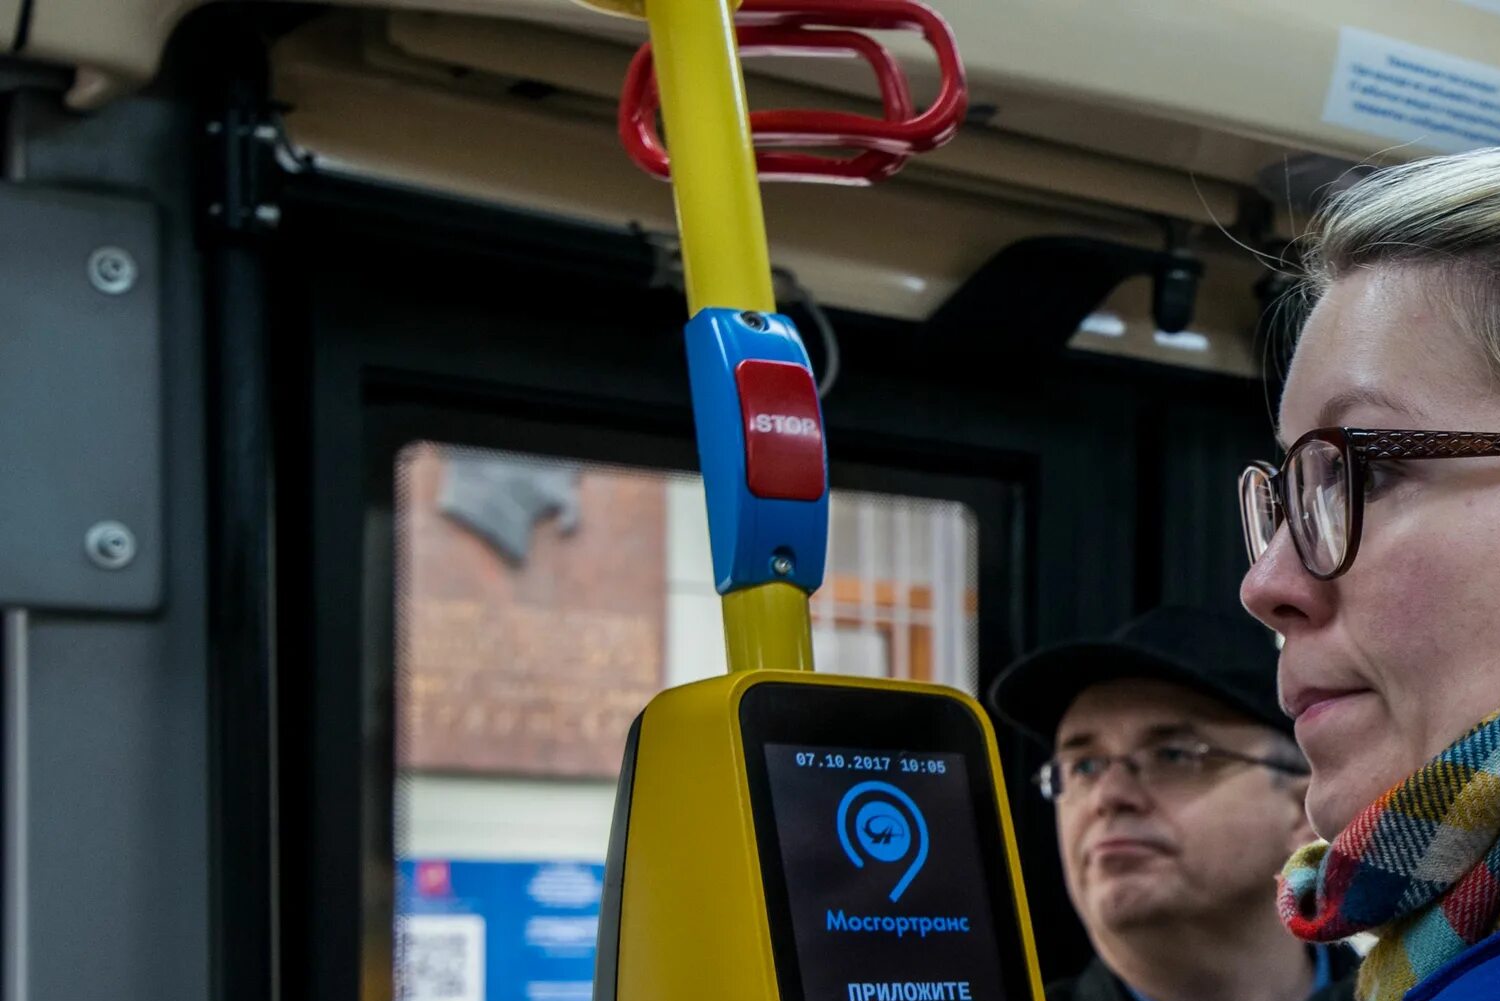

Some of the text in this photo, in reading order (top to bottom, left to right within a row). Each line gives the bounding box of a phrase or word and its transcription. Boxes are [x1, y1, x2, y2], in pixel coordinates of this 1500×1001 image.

[754, 413, 818, 436] STOP
[796, 752, 947, 774] 07.10.2017 10:05
[827, 908, 970, 938] Мосгортранс
